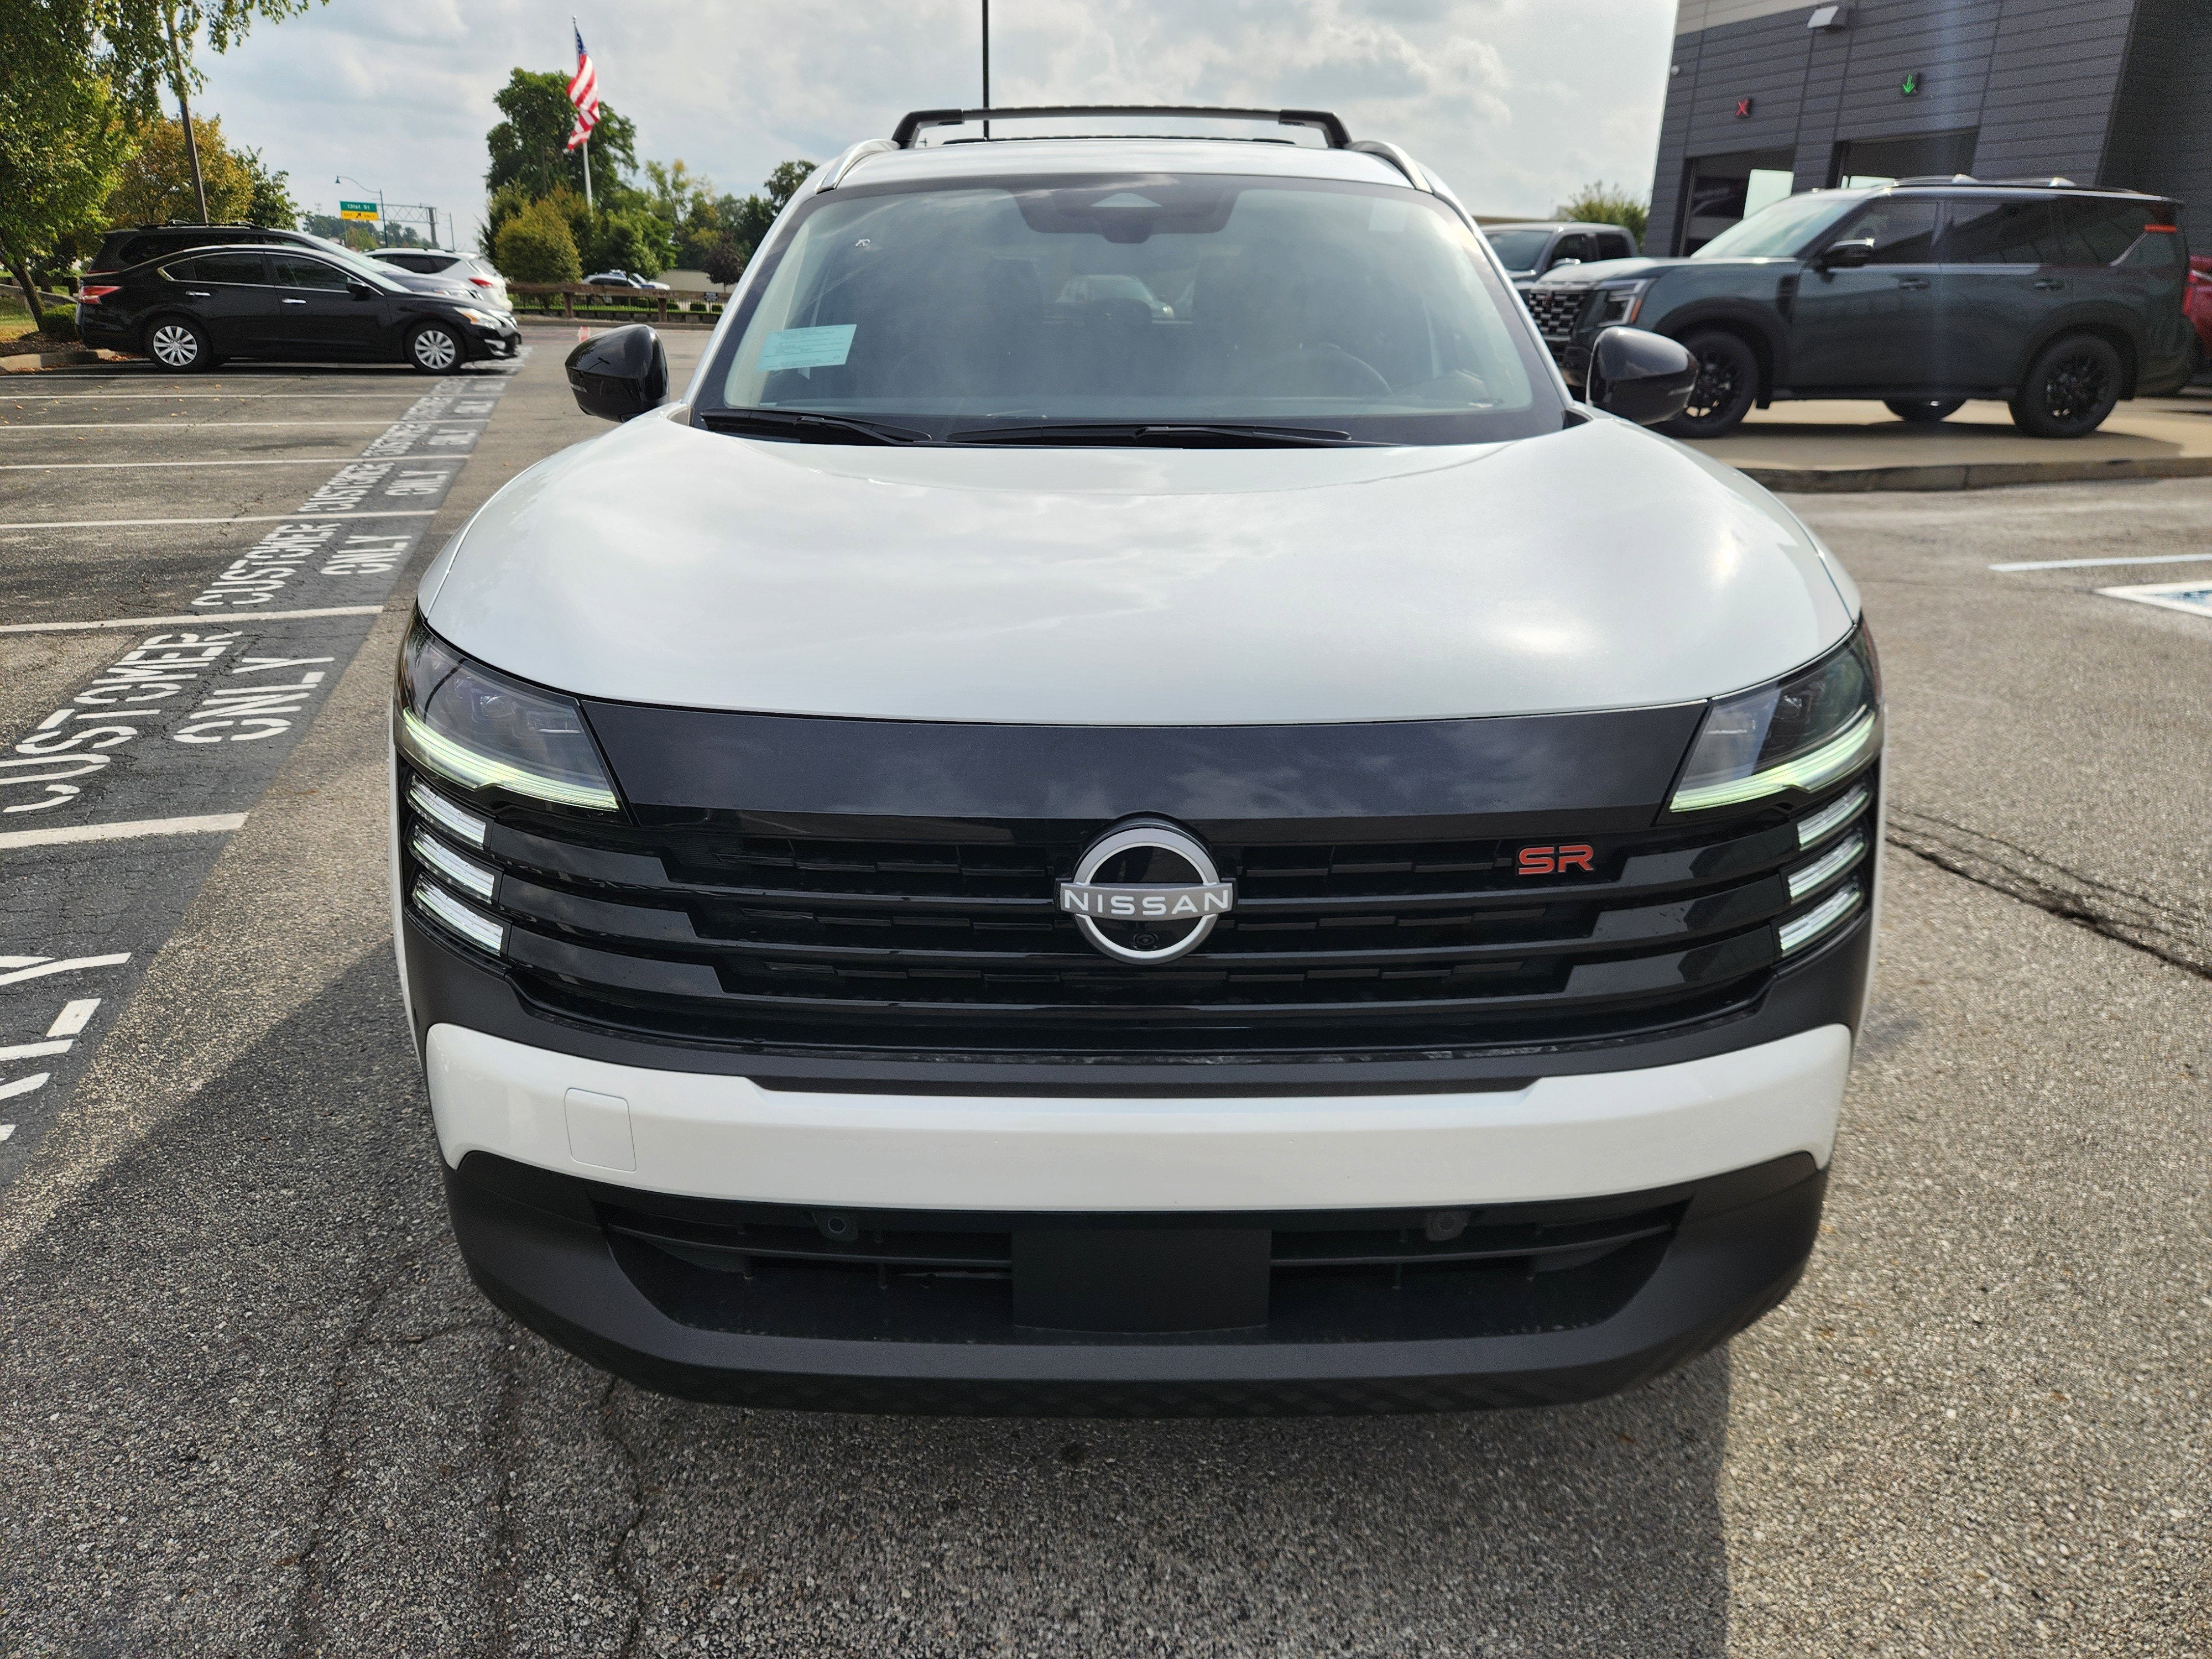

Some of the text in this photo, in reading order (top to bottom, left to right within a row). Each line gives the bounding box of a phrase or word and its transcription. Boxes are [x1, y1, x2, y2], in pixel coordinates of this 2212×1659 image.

[191, 523, 341, 606] CUSTOMER
[320, 536, 412, 575] ONLY
[174, 657, 335, 743] ONLY
[1519, 844, 1594, 875] SR
[1064, 889, 1229, 916] NISSAN
